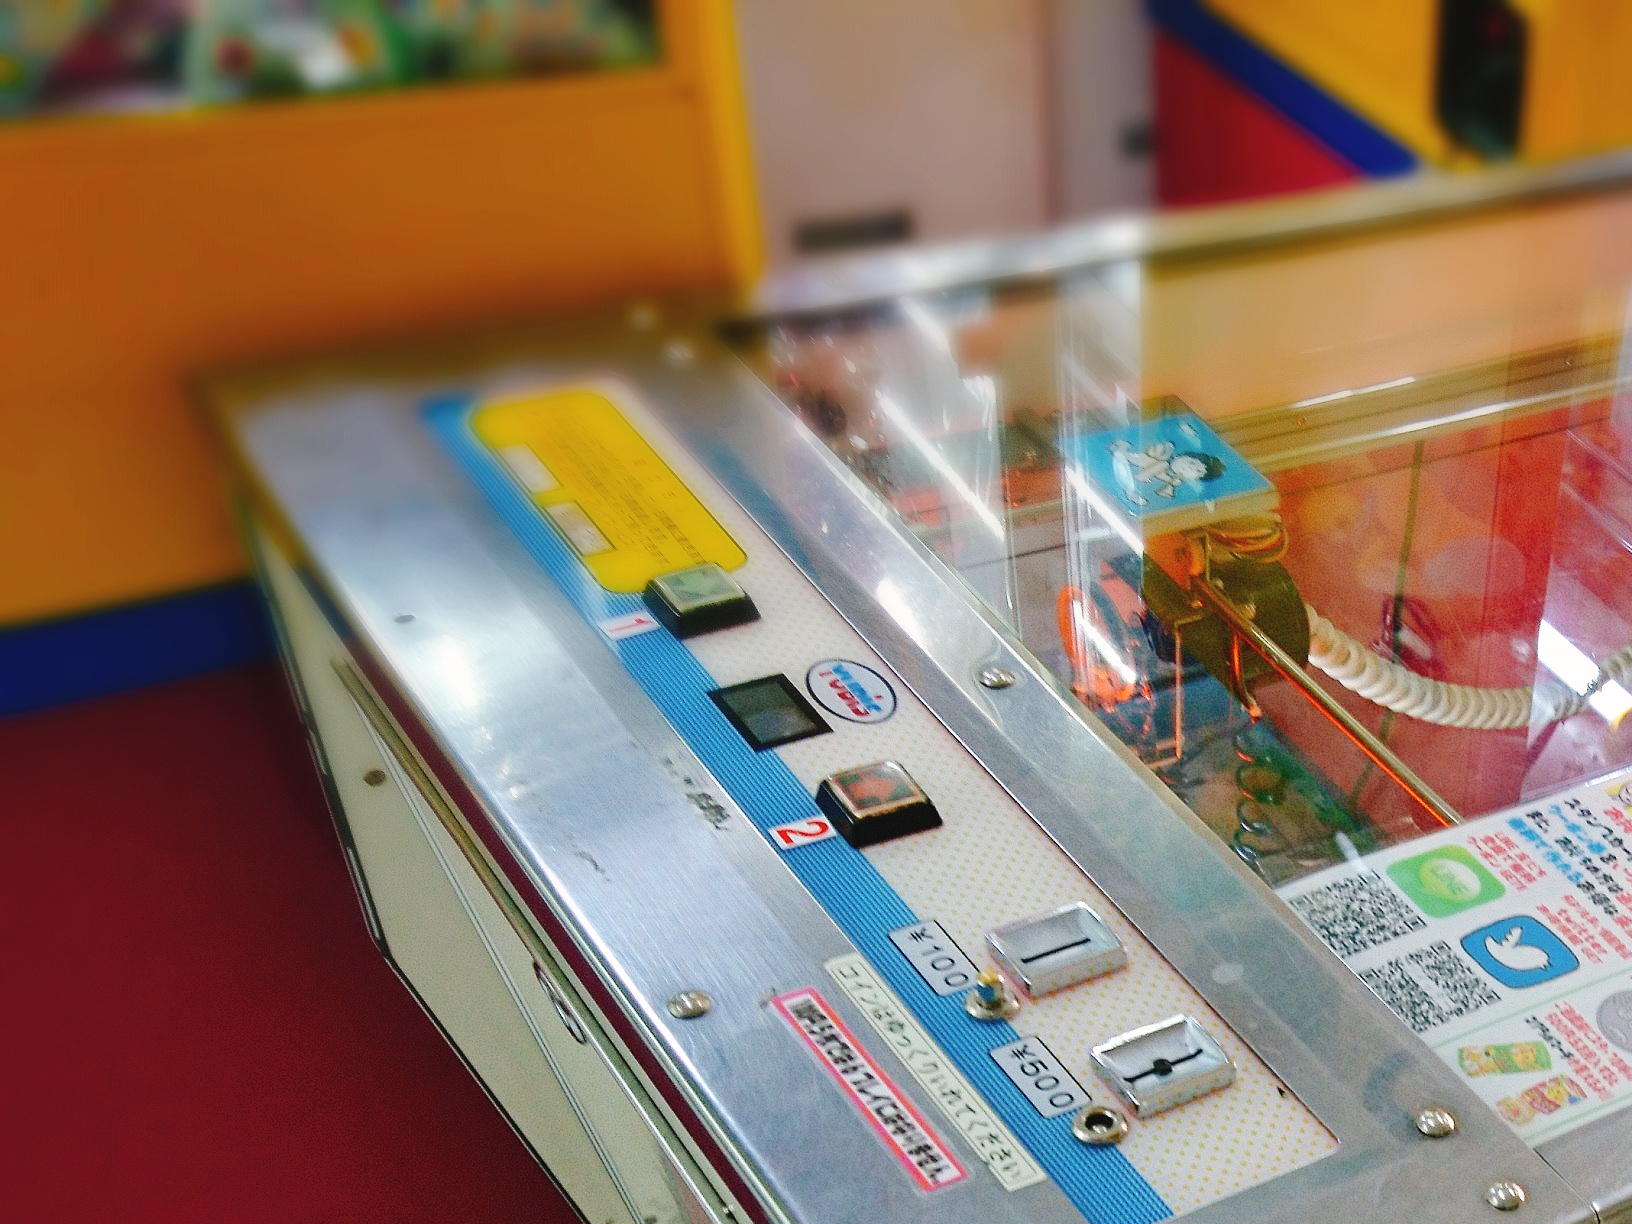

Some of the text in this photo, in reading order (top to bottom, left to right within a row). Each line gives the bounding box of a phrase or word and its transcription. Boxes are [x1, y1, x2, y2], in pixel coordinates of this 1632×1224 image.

[608, 617, 653, 635] 1
[776, 820, 829, 846] 2
[909, 926, 969, 987] ¥100
[838, 966, 1023, 1180] コインはゆっくりいれてください
[1011, 1045, 1076, 1108] ¥500
